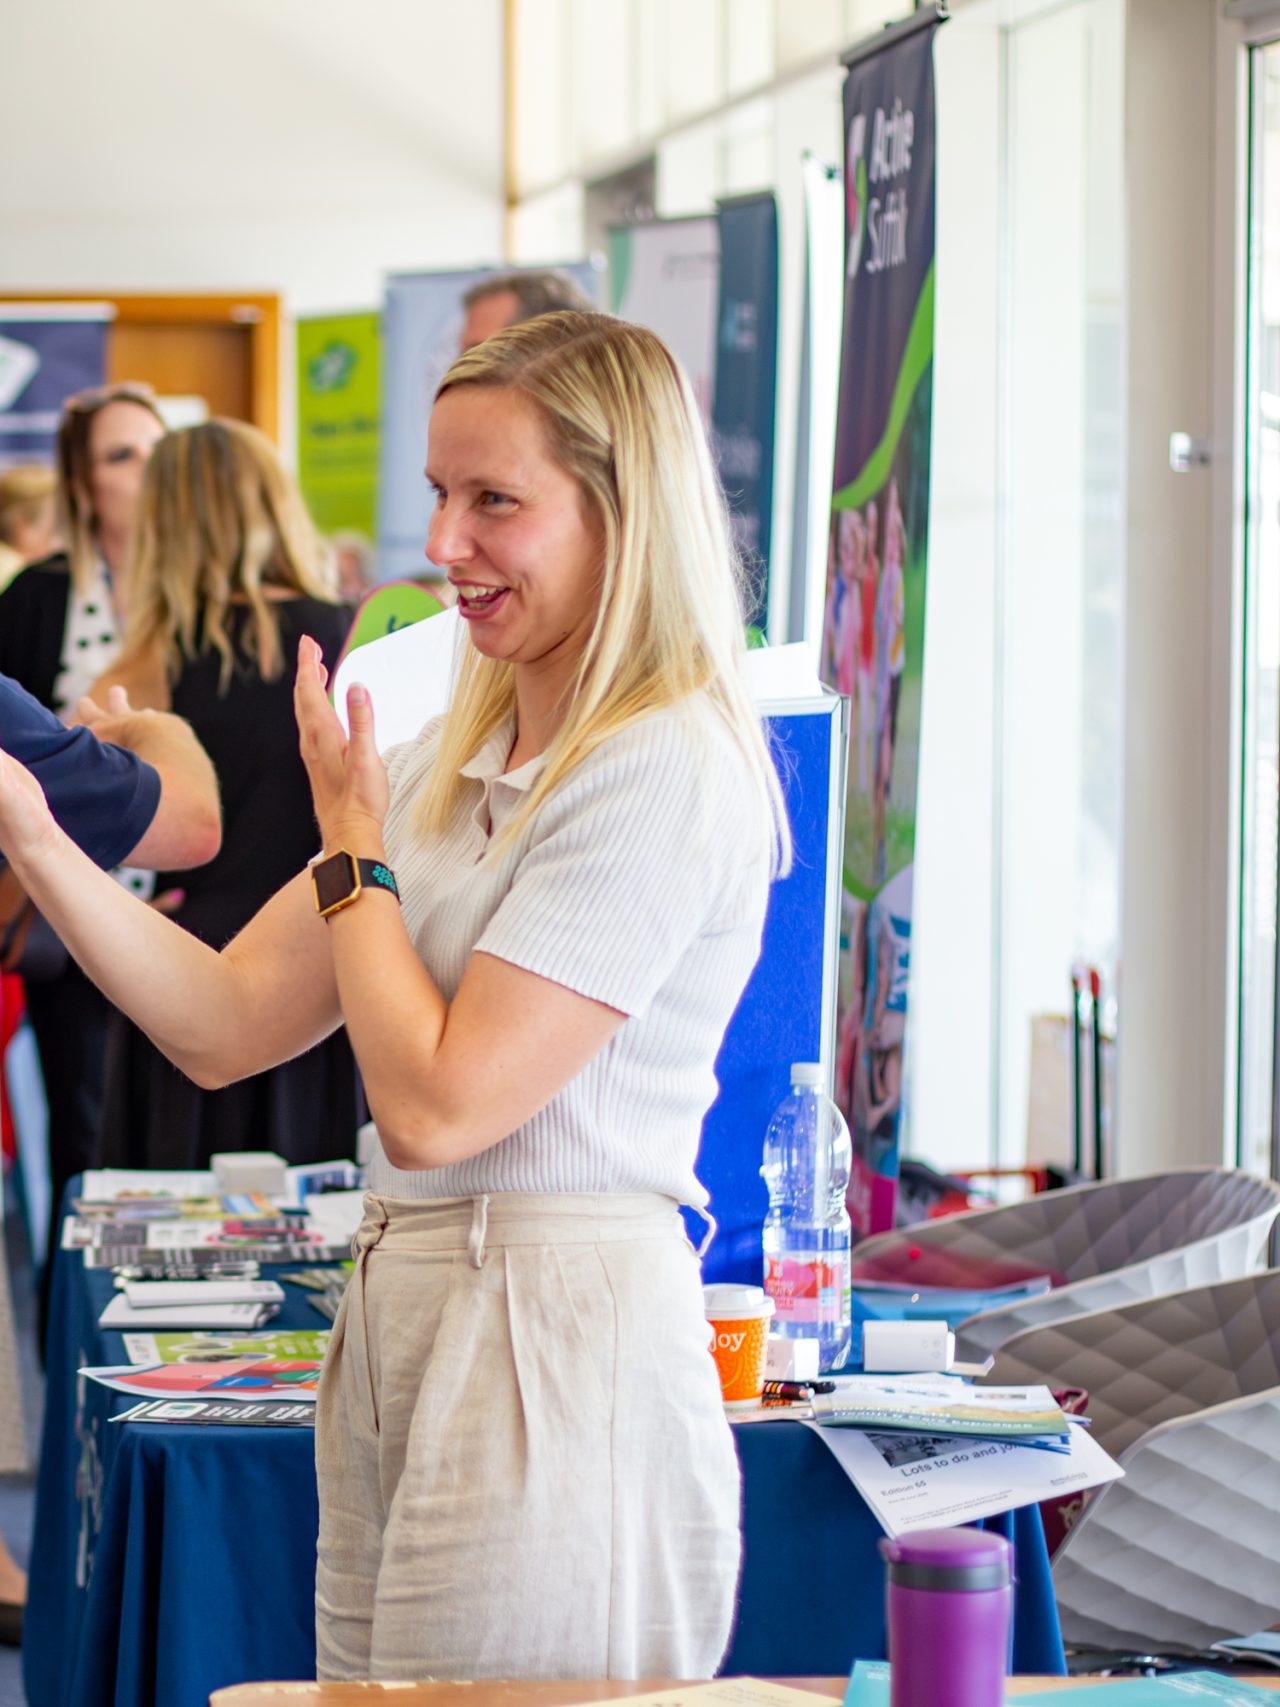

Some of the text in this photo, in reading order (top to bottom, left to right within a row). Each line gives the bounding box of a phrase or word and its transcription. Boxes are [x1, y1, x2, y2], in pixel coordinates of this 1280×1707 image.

[901, 1442, 1021, 1477] Lots to do and jo
[881, 1484, 914, 1497] Edition
